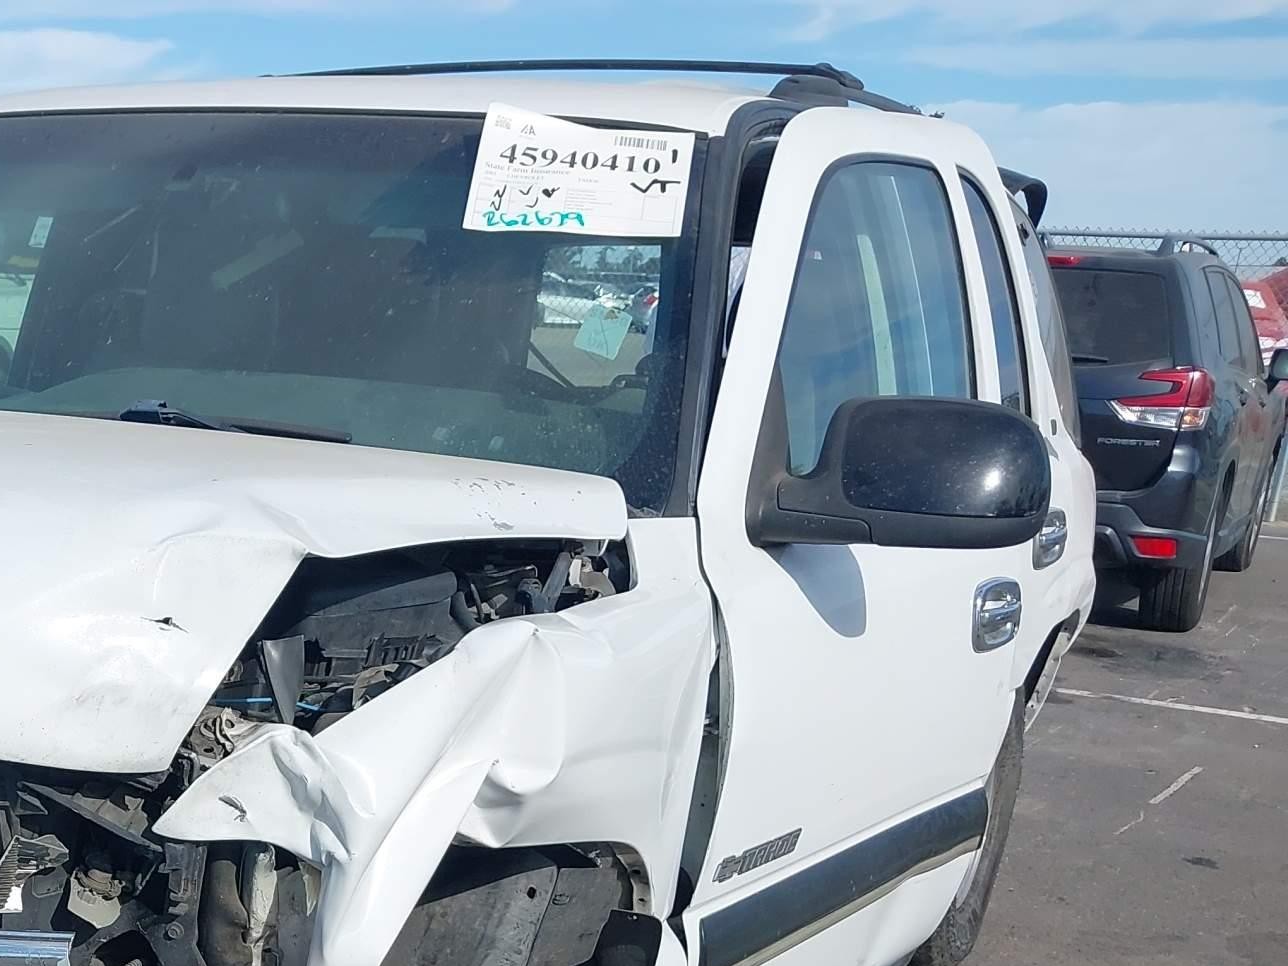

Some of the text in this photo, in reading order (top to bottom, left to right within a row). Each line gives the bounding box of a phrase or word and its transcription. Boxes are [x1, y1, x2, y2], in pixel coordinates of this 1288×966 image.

[485, 161, 505, 171] State
[507, 165, 528, 174] Farm
[530, 167, 571, 176] Insurance
[499, 143, 662, 175] 45940410
[1096, 437, 1161, 448] FORESTER
[737, 828, 802, 876] TAHOE
